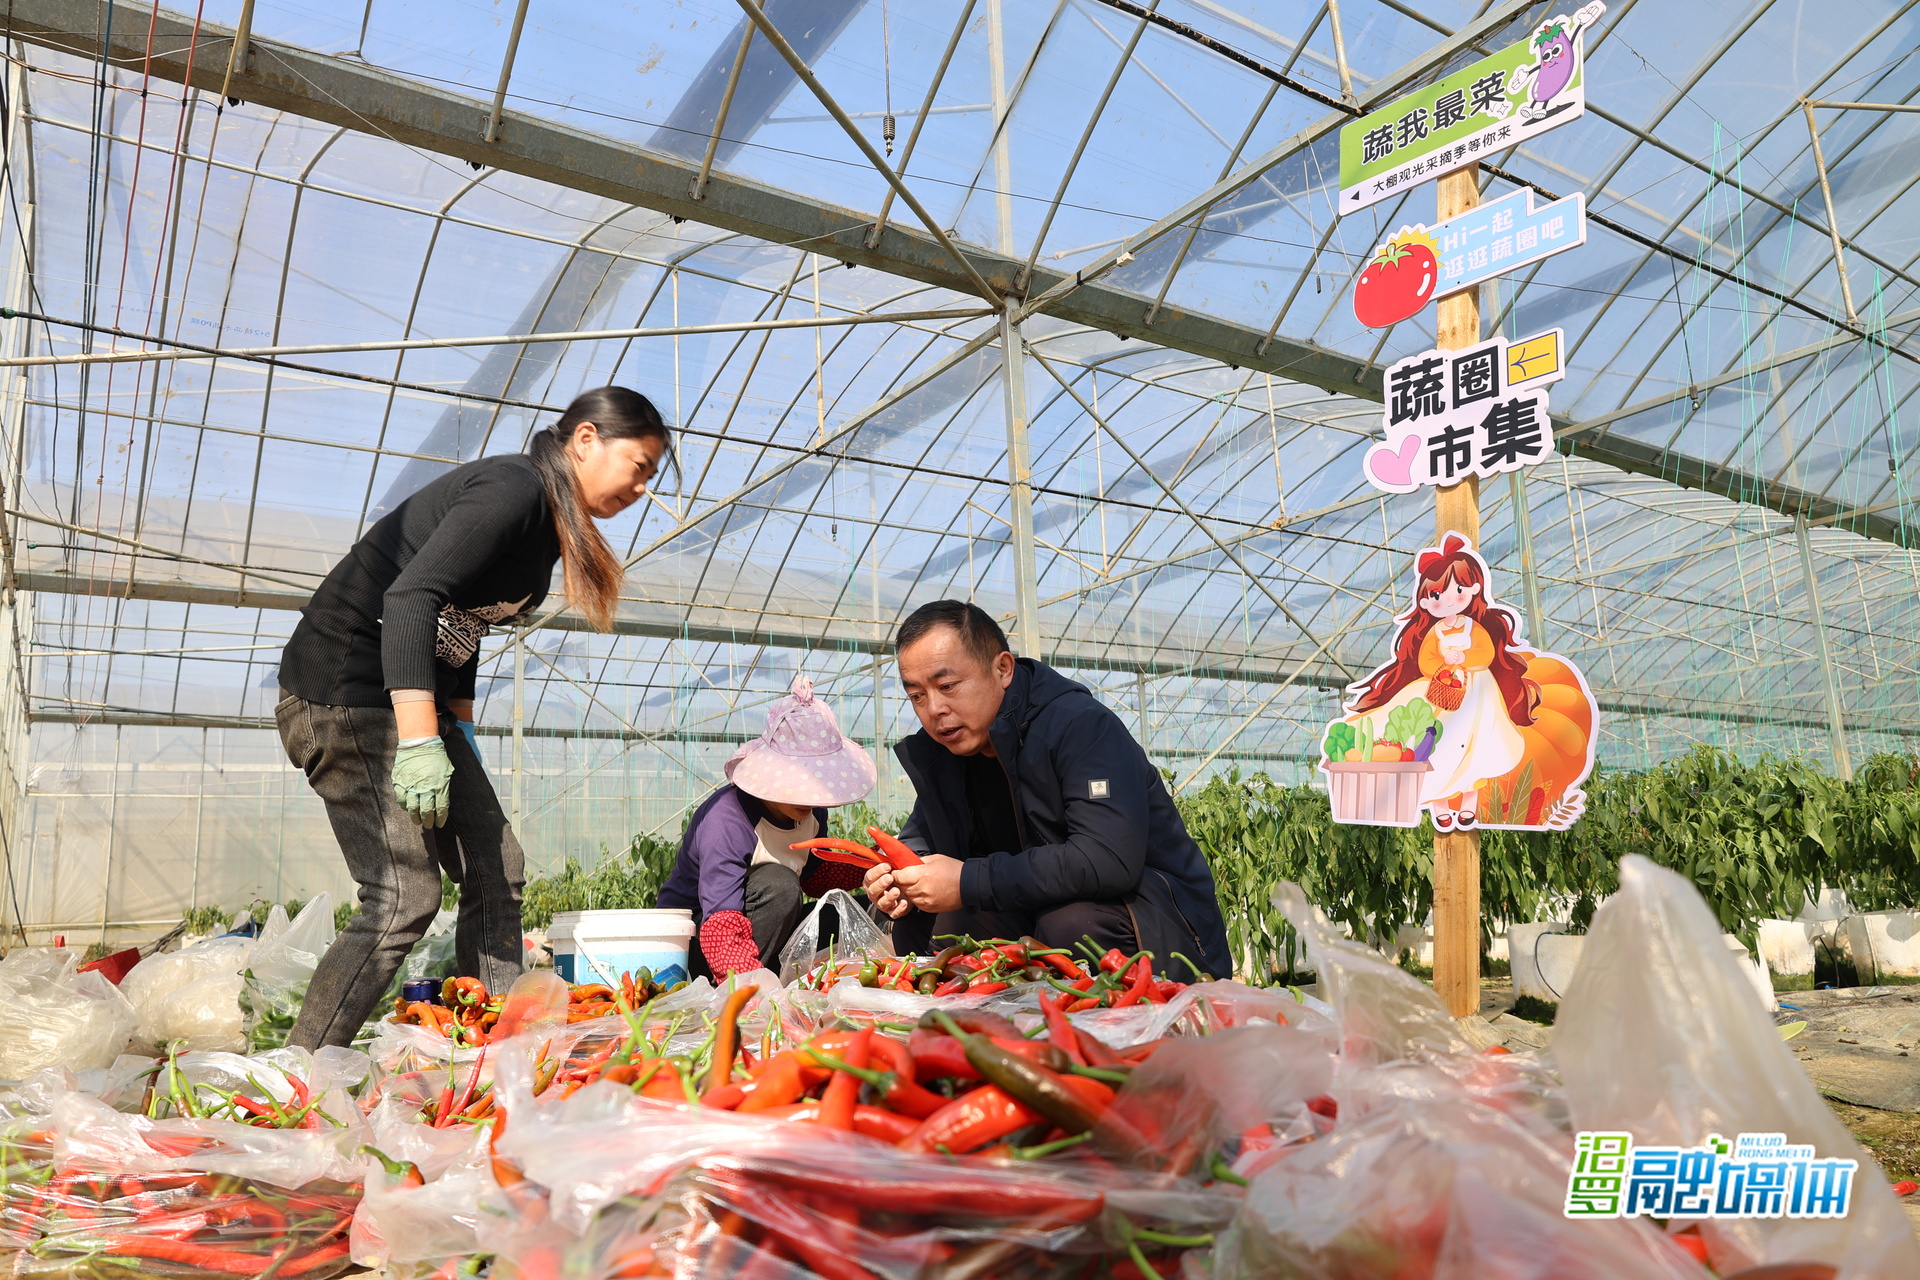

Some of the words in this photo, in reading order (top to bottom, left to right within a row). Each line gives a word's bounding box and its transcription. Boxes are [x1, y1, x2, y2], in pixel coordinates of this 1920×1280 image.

[1361, 71, 1506, 165] 蔬我最菜
[1372, 125, 1512, 195] 大棚观光采摘季等你来
[1443, 208, 1514, 251] Hi一起
[1443, 215, 1565, 281] 逛逛蔬圈吧
[1389, 345, 1500, 427] 蔬圈
[1427, 397, 1543, 479] 市集
